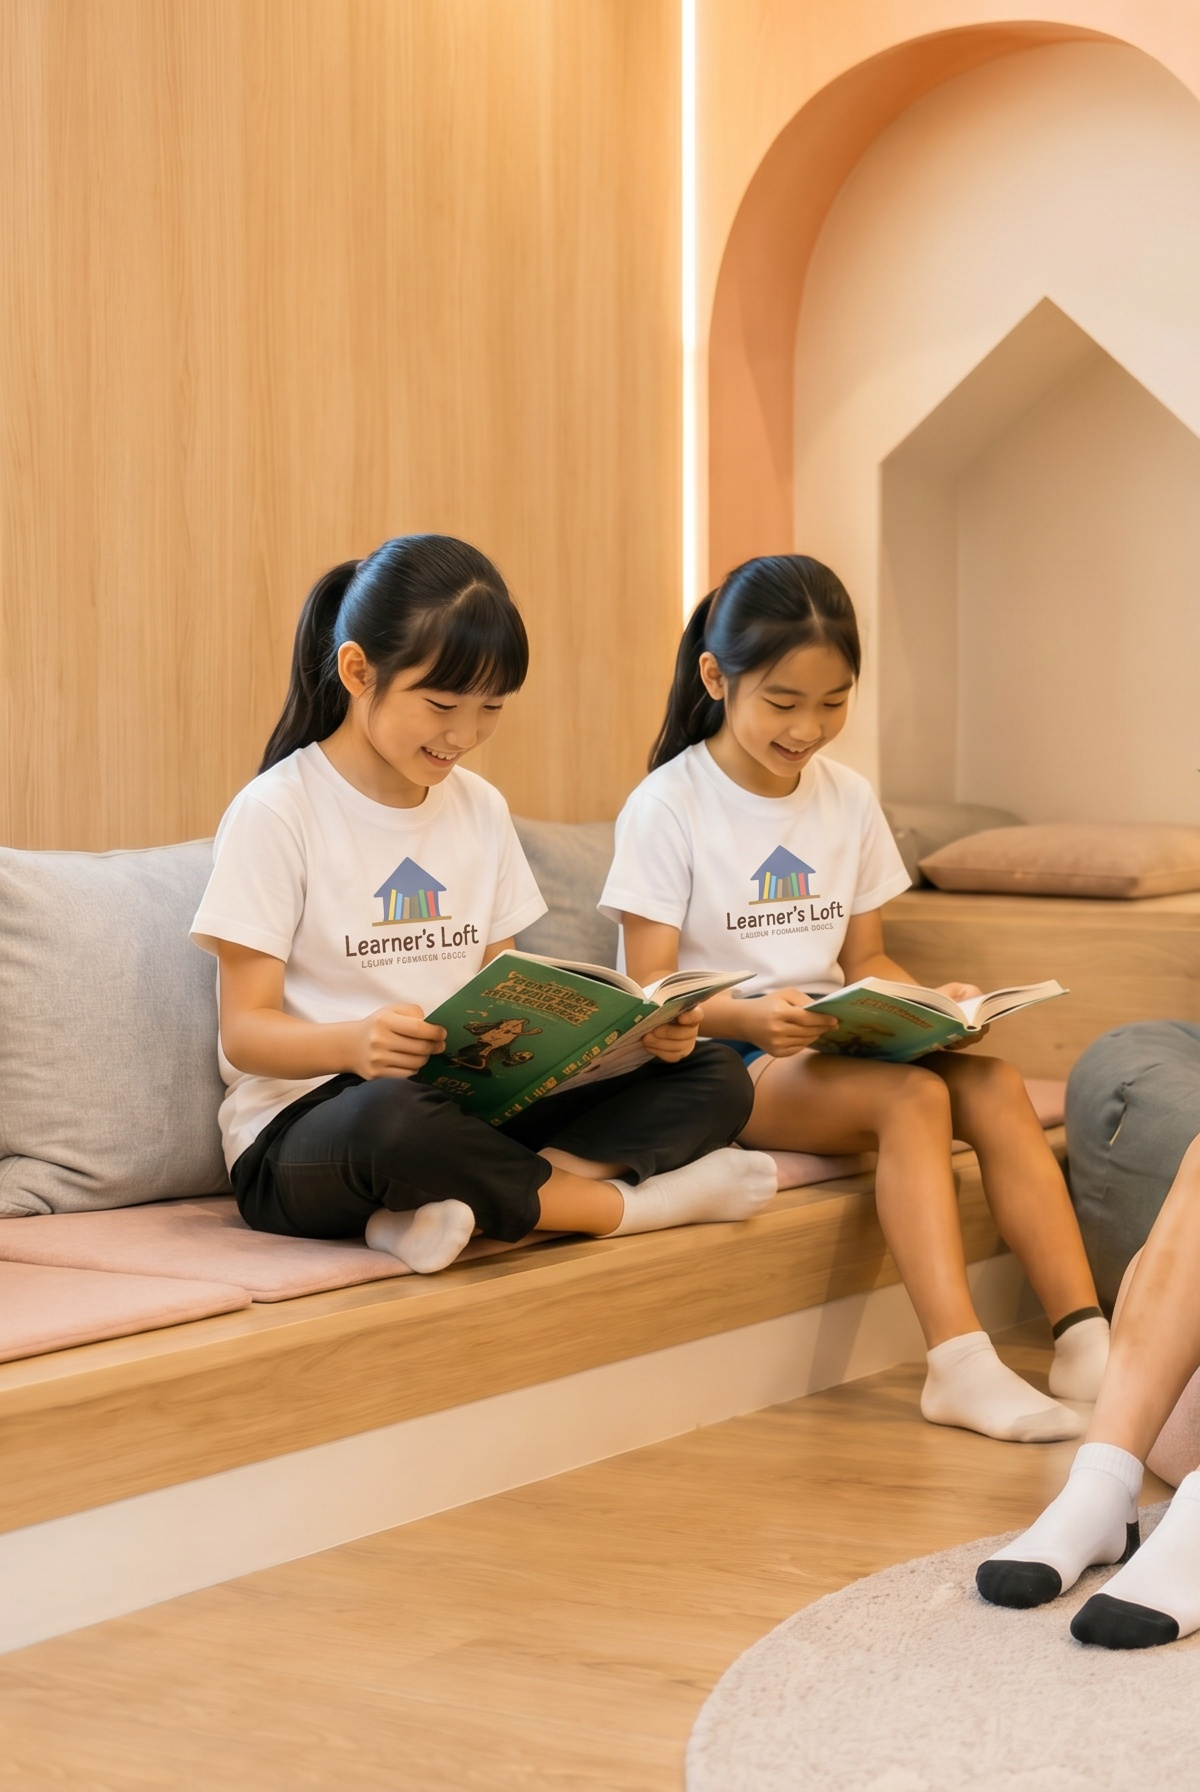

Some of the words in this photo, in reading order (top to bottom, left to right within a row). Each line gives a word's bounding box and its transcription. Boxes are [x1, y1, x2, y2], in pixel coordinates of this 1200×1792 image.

[726, 906, 805, 930] Learner's
[810, 901, 844, 922] Loft
[345, 928, 435, 957] Learner's
[441, 924, 479, 948] Loft
